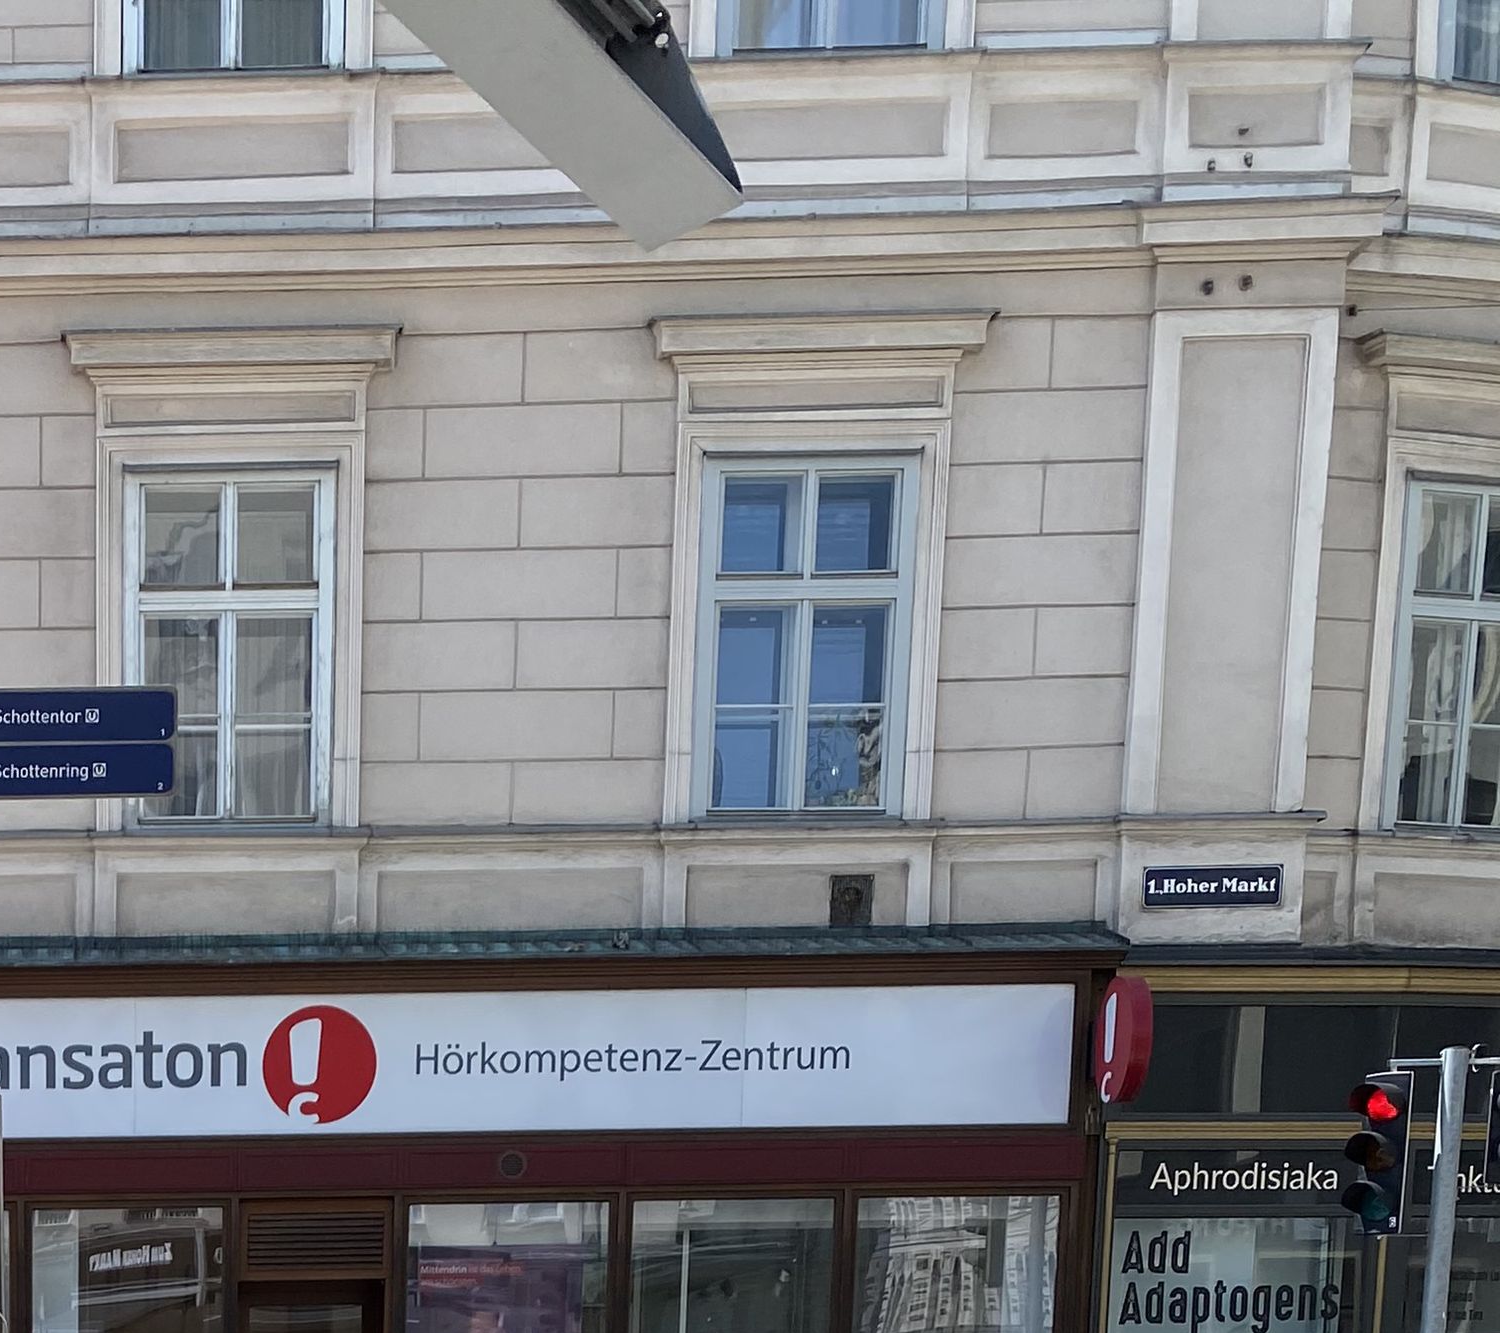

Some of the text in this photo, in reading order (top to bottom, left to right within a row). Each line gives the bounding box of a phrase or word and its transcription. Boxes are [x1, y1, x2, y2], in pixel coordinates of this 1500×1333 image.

[160, 728, 165, 736] 1
[157, 782, 164, 791] 2
[1222, 877, 1277, 893] Markt
[414, 1038, 852, 1081] Hörkompetenz-Zentrum
[1150, 1162, 1339, 1196] Aphrodisiaka
[1121, 1230, 1192, 1274] Add
